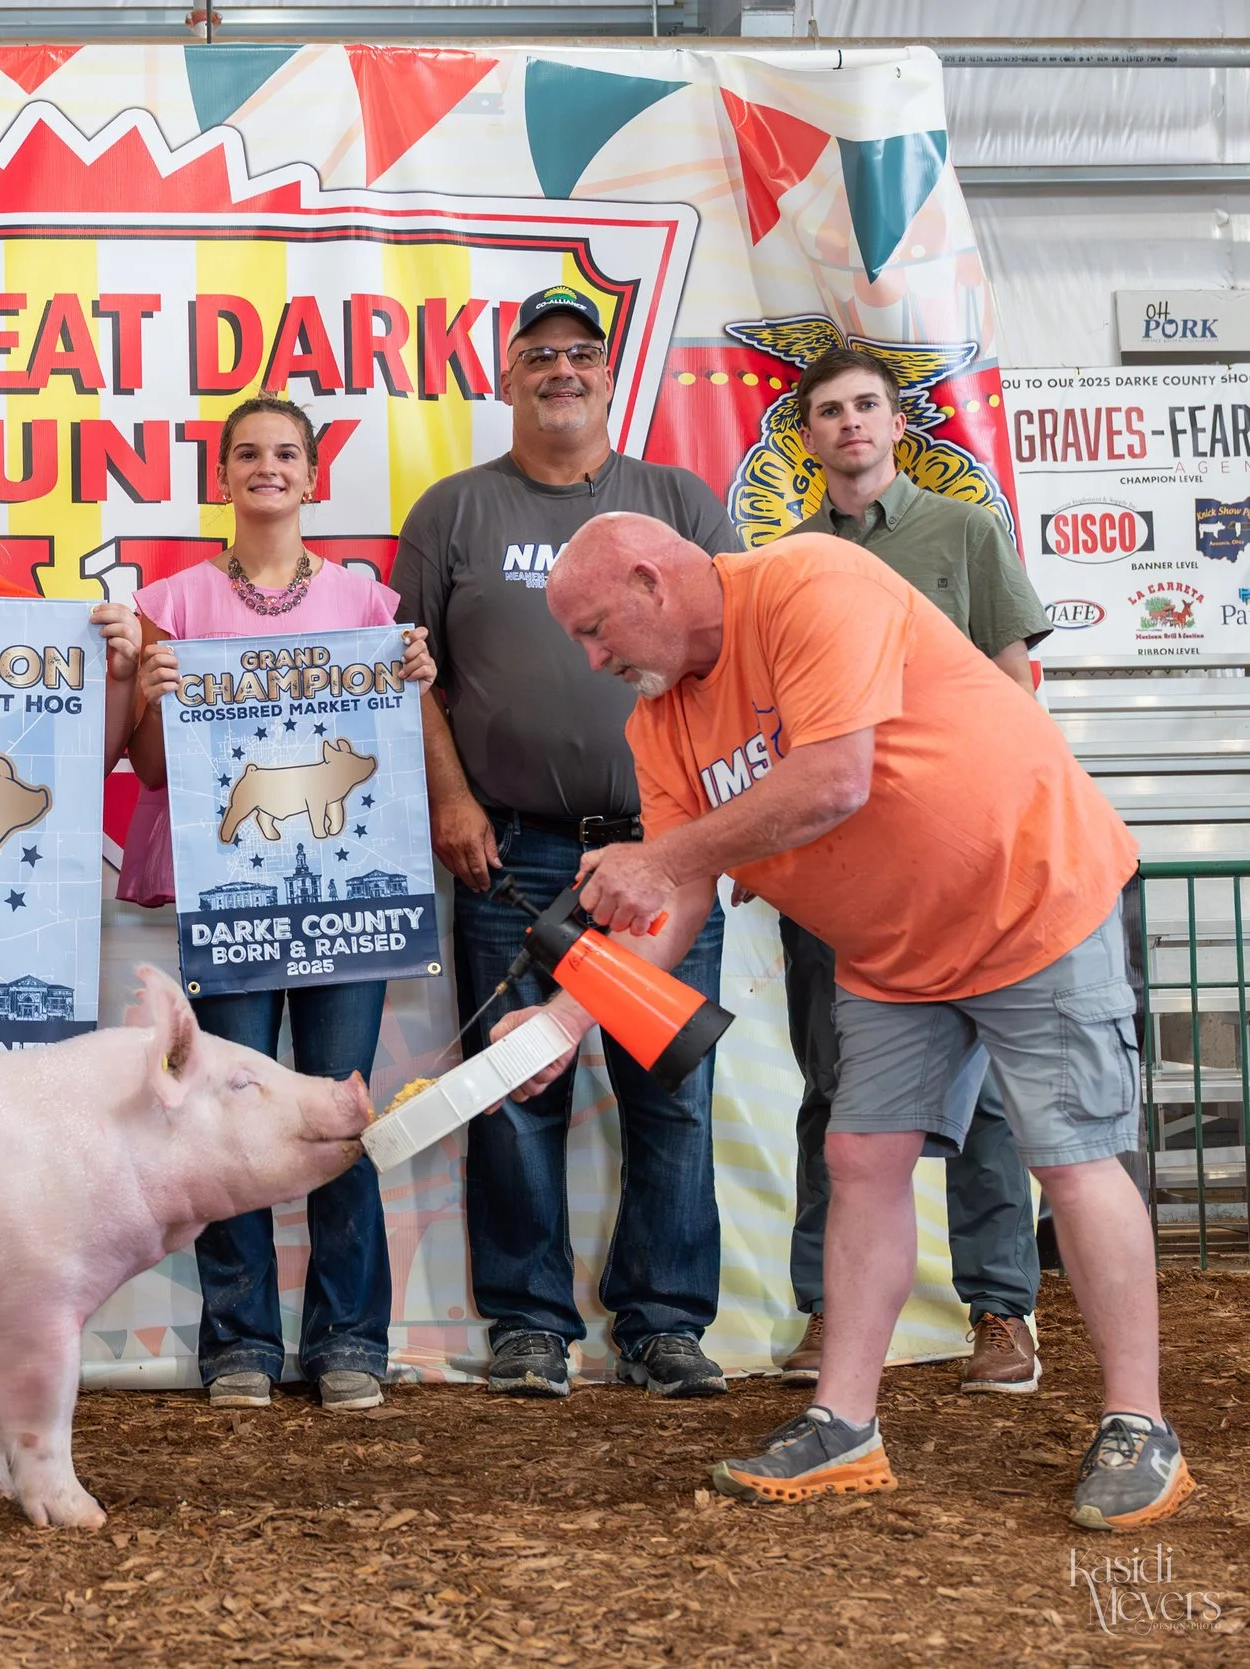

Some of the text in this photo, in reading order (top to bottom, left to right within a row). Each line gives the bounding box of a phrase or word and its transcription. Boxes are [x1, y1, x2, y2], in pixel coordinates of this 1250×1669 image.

[535, 298, 588, 311] CO-ALLIANCE
[1146, 300, 1171, 321] OH
[1141, 318, 1220, 339] PORK
[188, 293, 520, 401] DARK
[1001, 373, 1250, 390] OU TO OUR 2025 DARKE COUNTY SHO
[1119, 475, 1204, 485] CHAMPION LEVEL
[1218, 506, 1242, 516] Show
[1054, 511, 1137, 555] SISCO
[502, 542, 569, 571] NM
[1131, 561, 1199, 571] BANNER LEVEL
[1127, 581, 1205, 606] LA CARRETA
[1051, 605, 1096, 623] JAFE
[1220, 604, 1250, 625] Pa
[240, 646, 331, 671] GRAND
[175, 660, 406, 707] CHAMPION
[25, 694, 83, 715] HOG
[179, 695, 403, 724] CROSSBRED MARKET GILT
[701, 731, 773, 809] MS
[191, 906, 425, 947] DARKE COUNTY
[212, 933, 407, 965] BORN & RAISED
[286, 958, 335, 976] 2025
